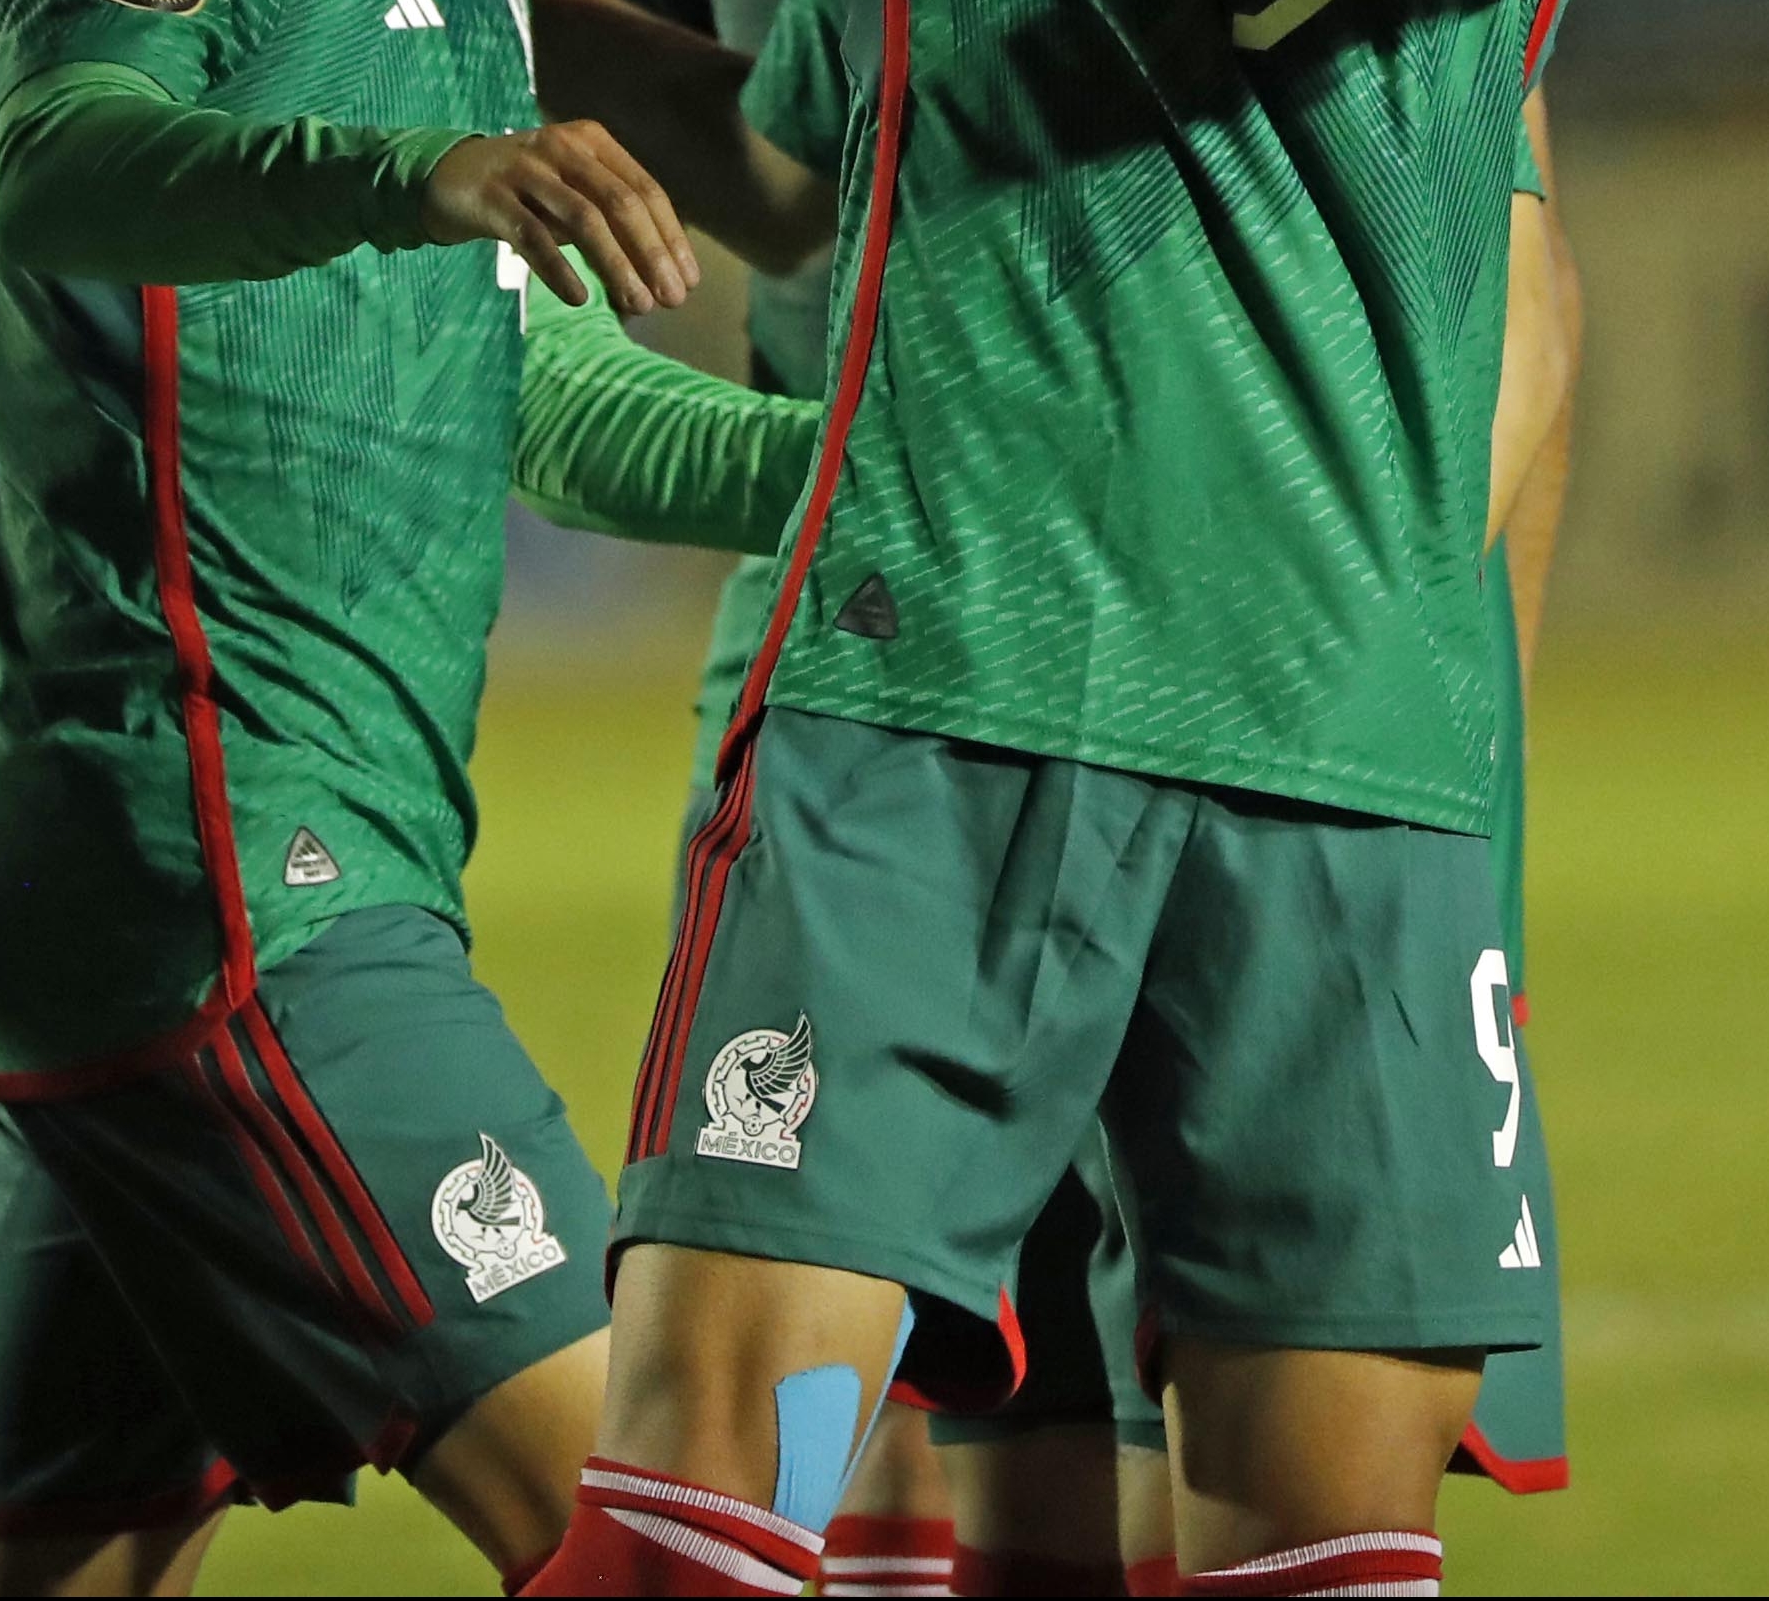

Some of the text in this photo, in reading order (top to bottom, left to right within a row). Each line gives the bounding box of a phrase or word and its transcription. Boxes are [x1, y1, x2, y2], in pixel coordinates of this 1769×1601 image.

[1470, 949, 1521, 1168] 9
[699, 1131, 798, 1163] MÉXICO
[471, 1243, 559, 1297] MÉXICO
